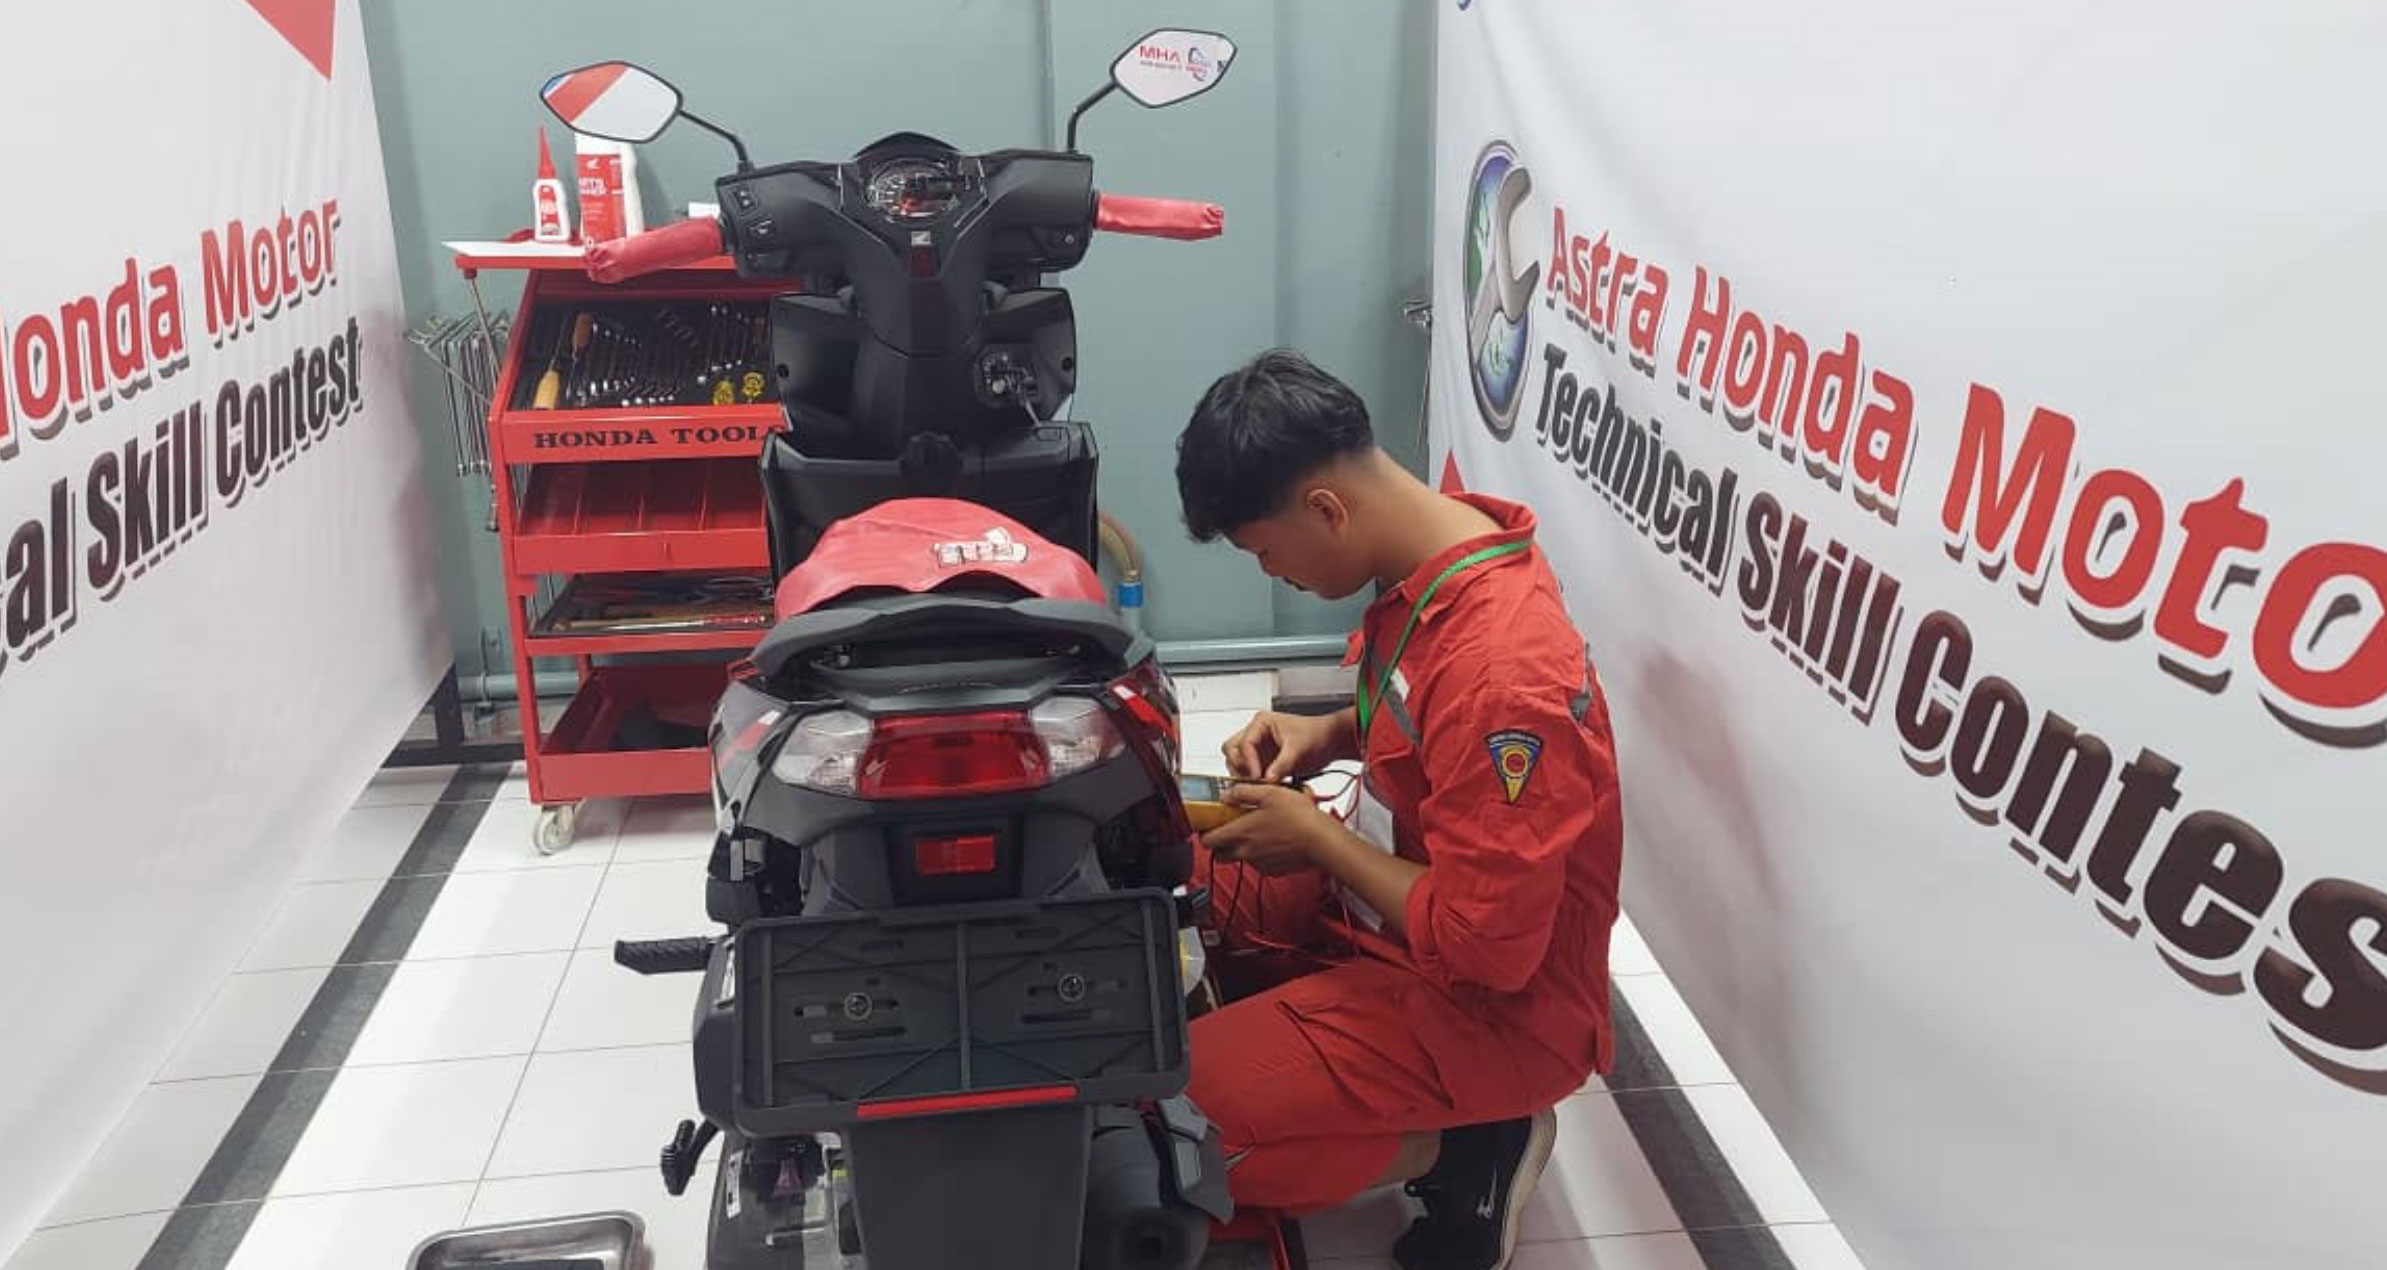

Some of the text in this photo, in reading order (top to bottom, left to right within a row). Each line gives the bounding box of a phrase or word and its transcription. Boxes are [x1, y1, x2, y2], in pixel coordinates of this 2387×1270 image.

[0, 200, 338, 438] onda Motor
[0, 317, 359, 649] al Skill Contest
[534, 429, 658, 449] HONDA
[1547, 206, 2387, 708] Astra Honda Moto
[1535, 342, 2387, 1050] Technical Skill Contes
